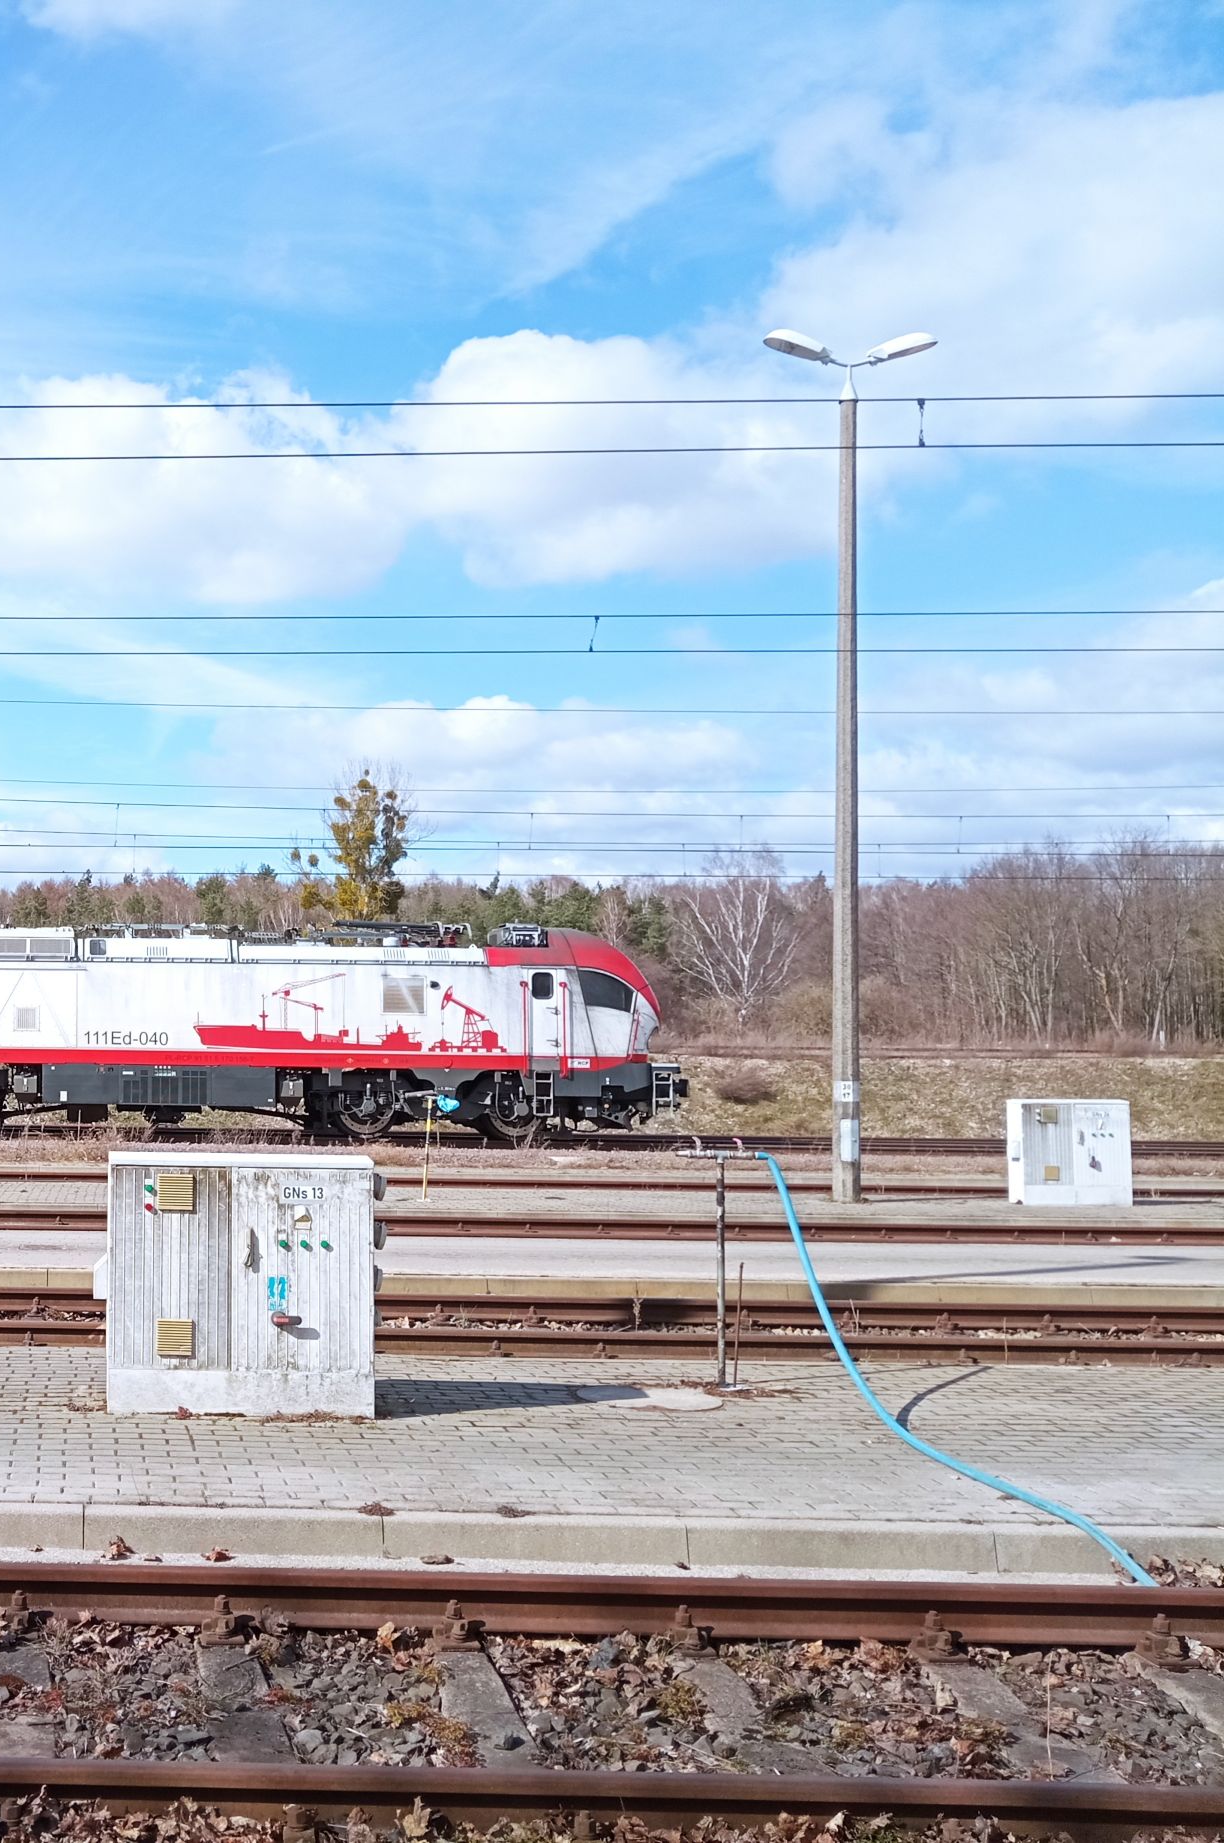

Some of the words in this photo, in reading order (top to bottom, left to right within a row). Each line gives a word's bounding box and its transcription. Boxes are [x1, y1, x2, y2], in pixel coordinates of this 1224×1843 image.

[84, 1031, 168, 1045] 111Ed-040
[283, 1186, 308, 1199] GNs
[312, 1187, 324, 1199] 13
